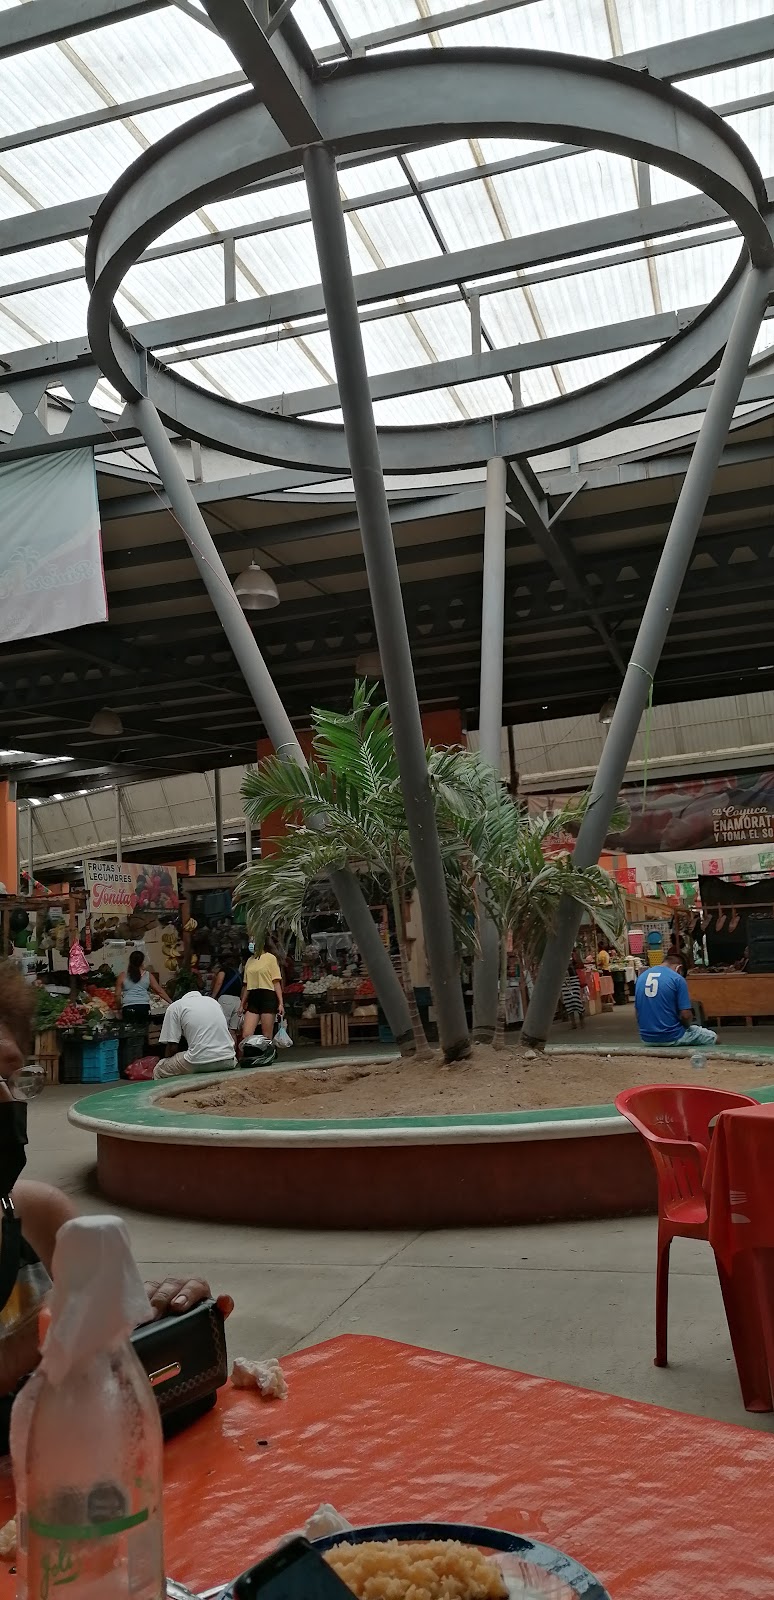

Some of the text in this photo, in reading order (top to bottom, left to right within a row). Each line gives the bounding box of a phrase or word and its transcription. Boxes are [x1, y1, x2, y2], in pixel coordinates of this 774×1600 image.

[722, 805, 769, 819] Coyuca
[713, 827, 774, 843] Y TOMA EL SO
[88, 862, 122, 873] FRUTAS Y
[89, 873, 132, 883] LEGUMBRES
[92, 883, 131, 908] Tonita
[644, 972, 662, 998] 5
